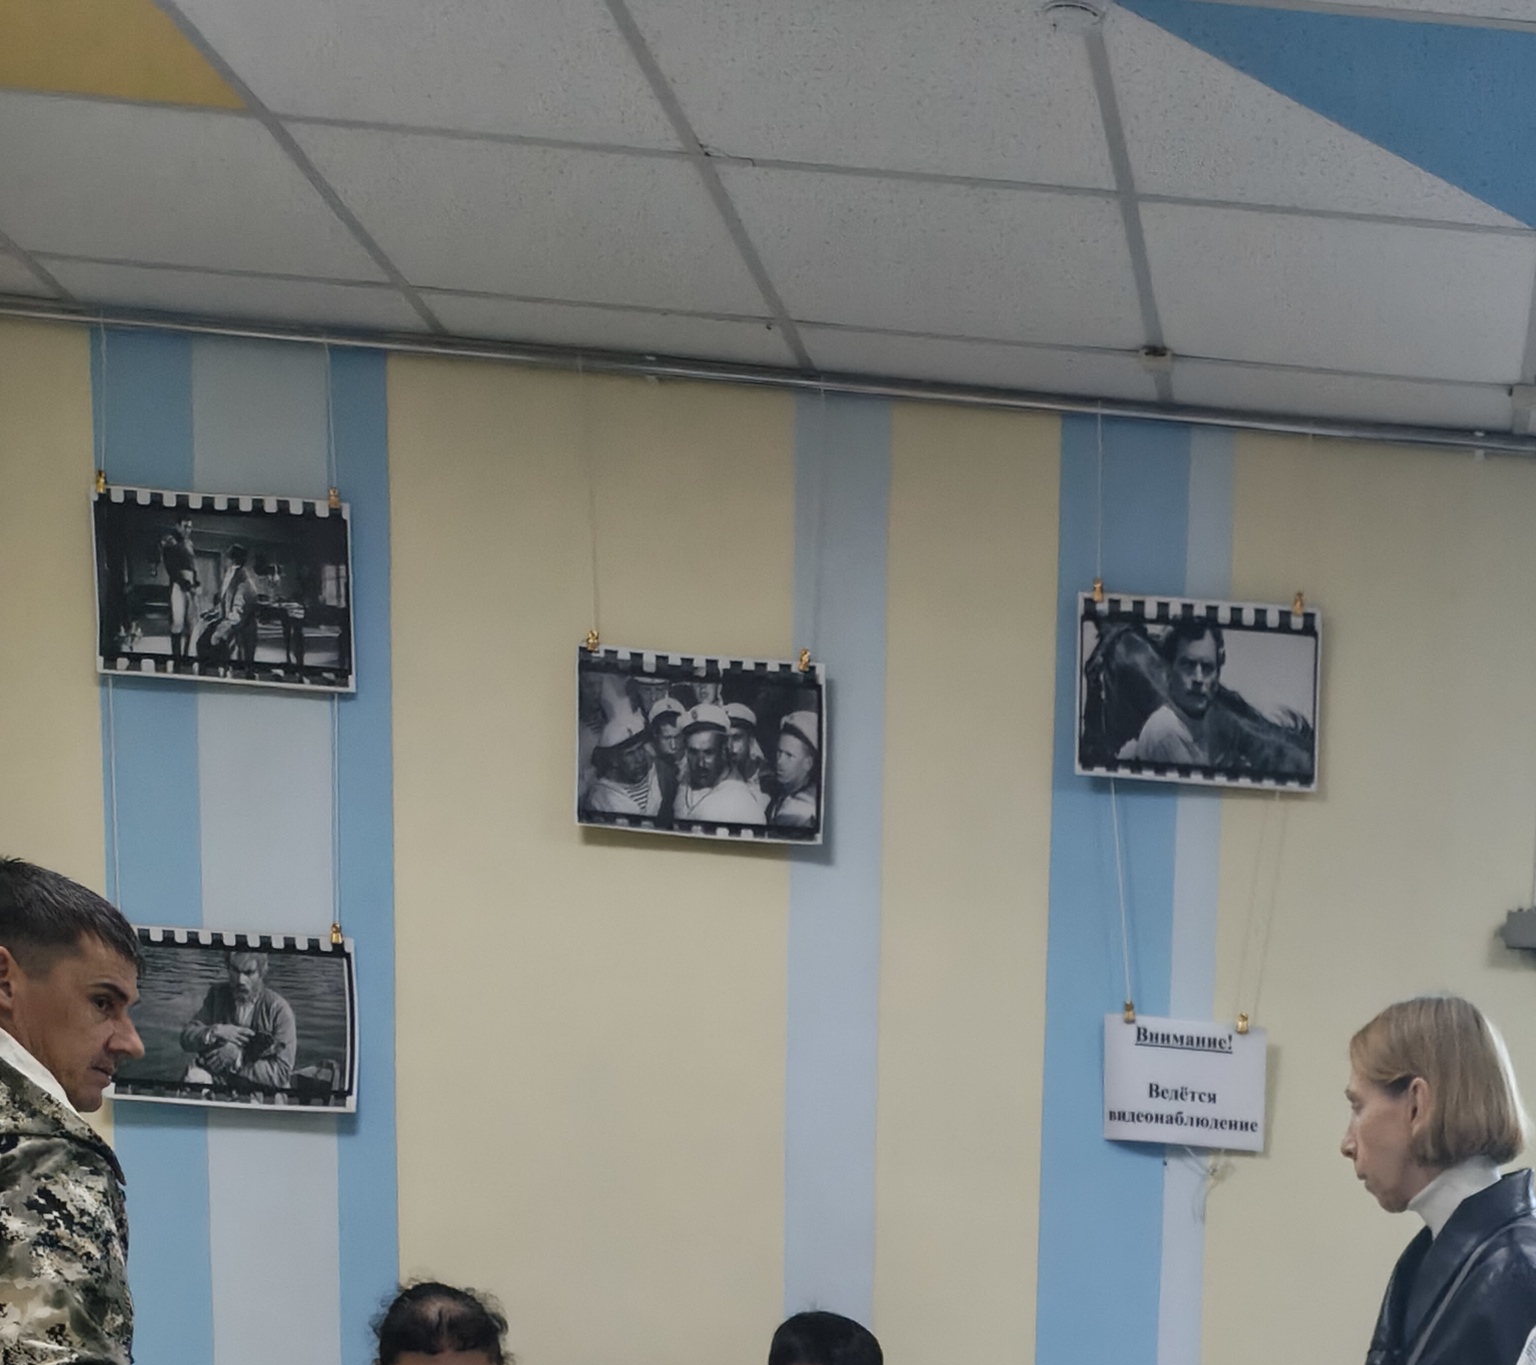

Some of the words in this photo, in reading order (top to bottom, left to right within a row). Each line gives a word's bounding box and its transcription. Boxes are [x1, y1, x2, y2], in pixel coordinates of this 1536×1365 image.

[1135, 1026, 1233, 1050] Внимание!
[1148, 1083, 1217, 1104] Ведётся
[1108, 1110, 1258, 1132] видеонаблюдение
